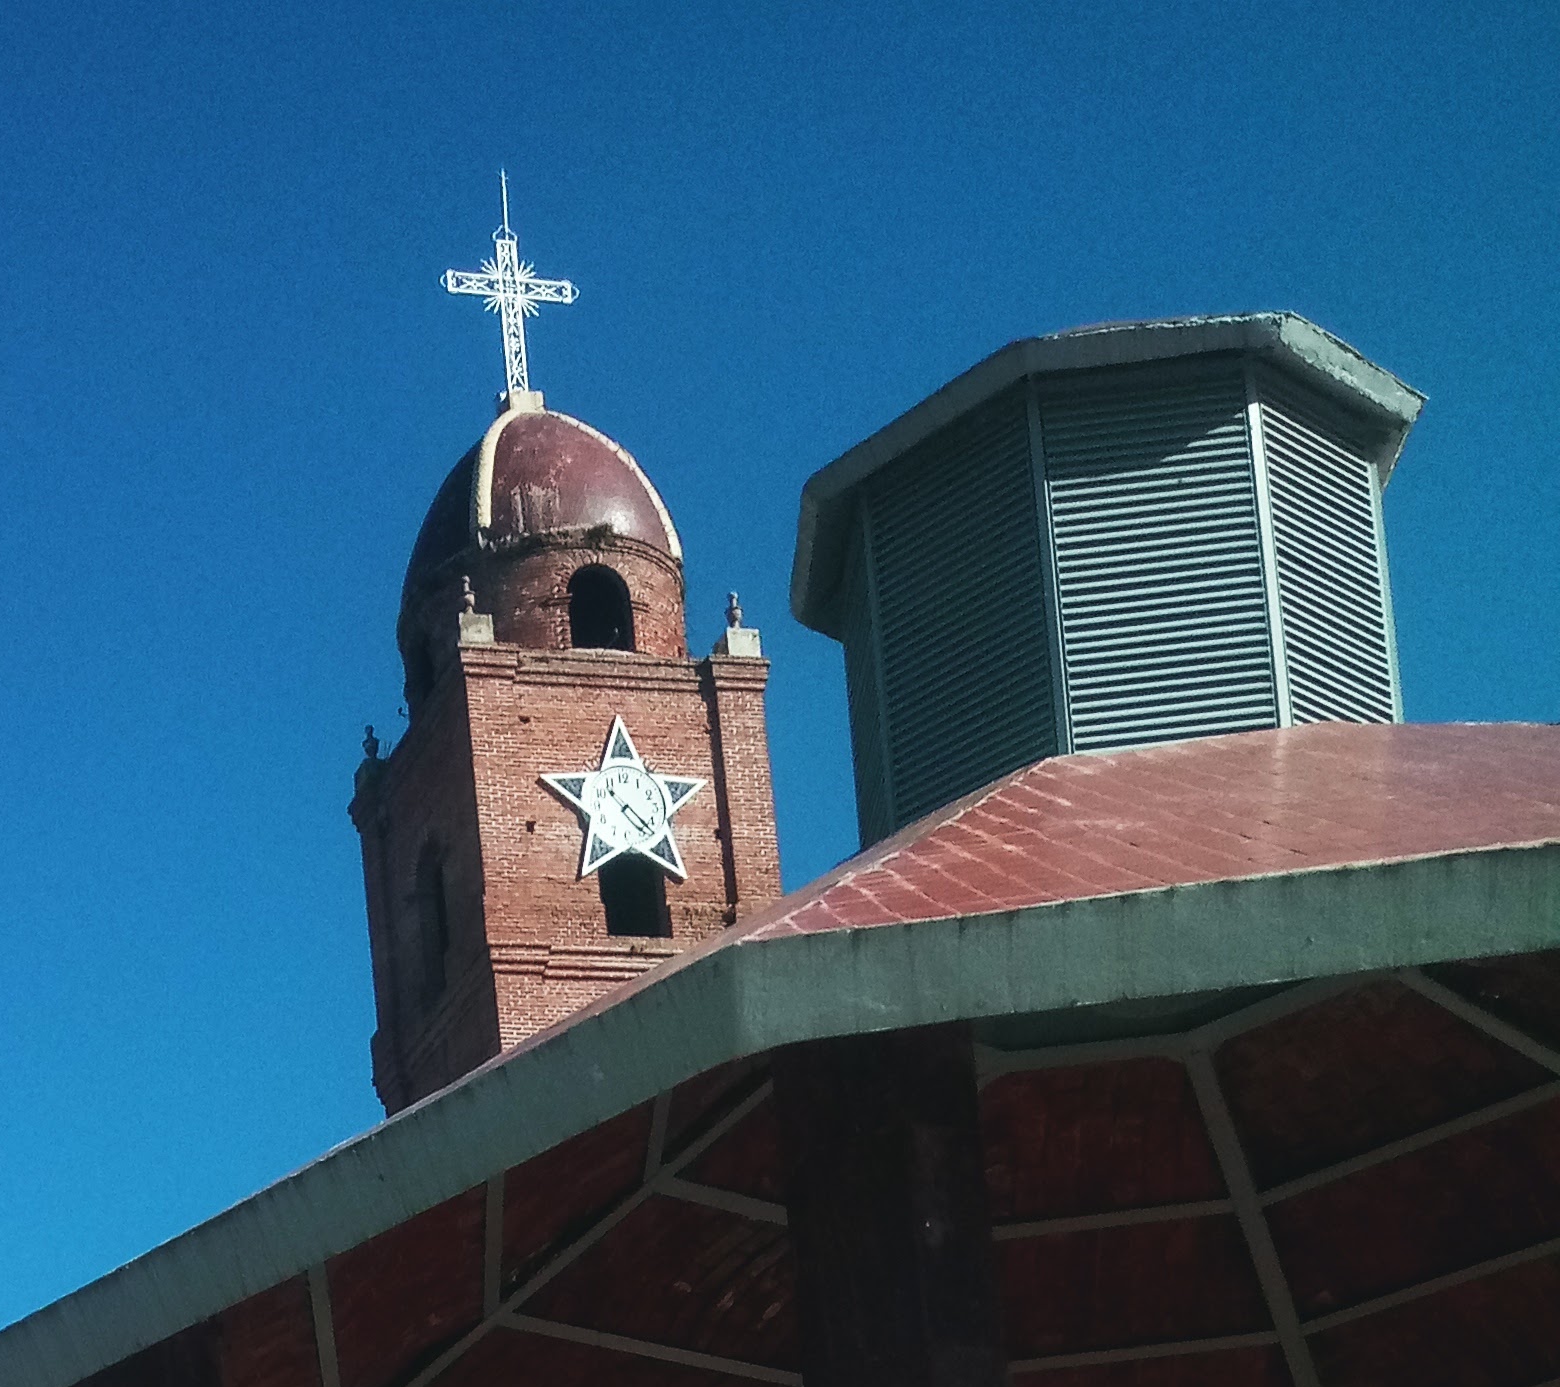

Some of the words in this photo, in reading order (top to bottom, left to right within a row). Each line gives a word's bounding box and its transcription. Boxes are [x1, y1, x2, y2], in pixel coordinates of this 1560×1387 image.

[618, 772, 628, 783] 12
[606, 778, 613, 788] 11
[635, 779, 640, 789] 1
[597, 789, 606, 798] 10
[645, 790, 652, 800] 2
[652, 803, 658, 813] 3
[648, 816, 654, 825] 4
